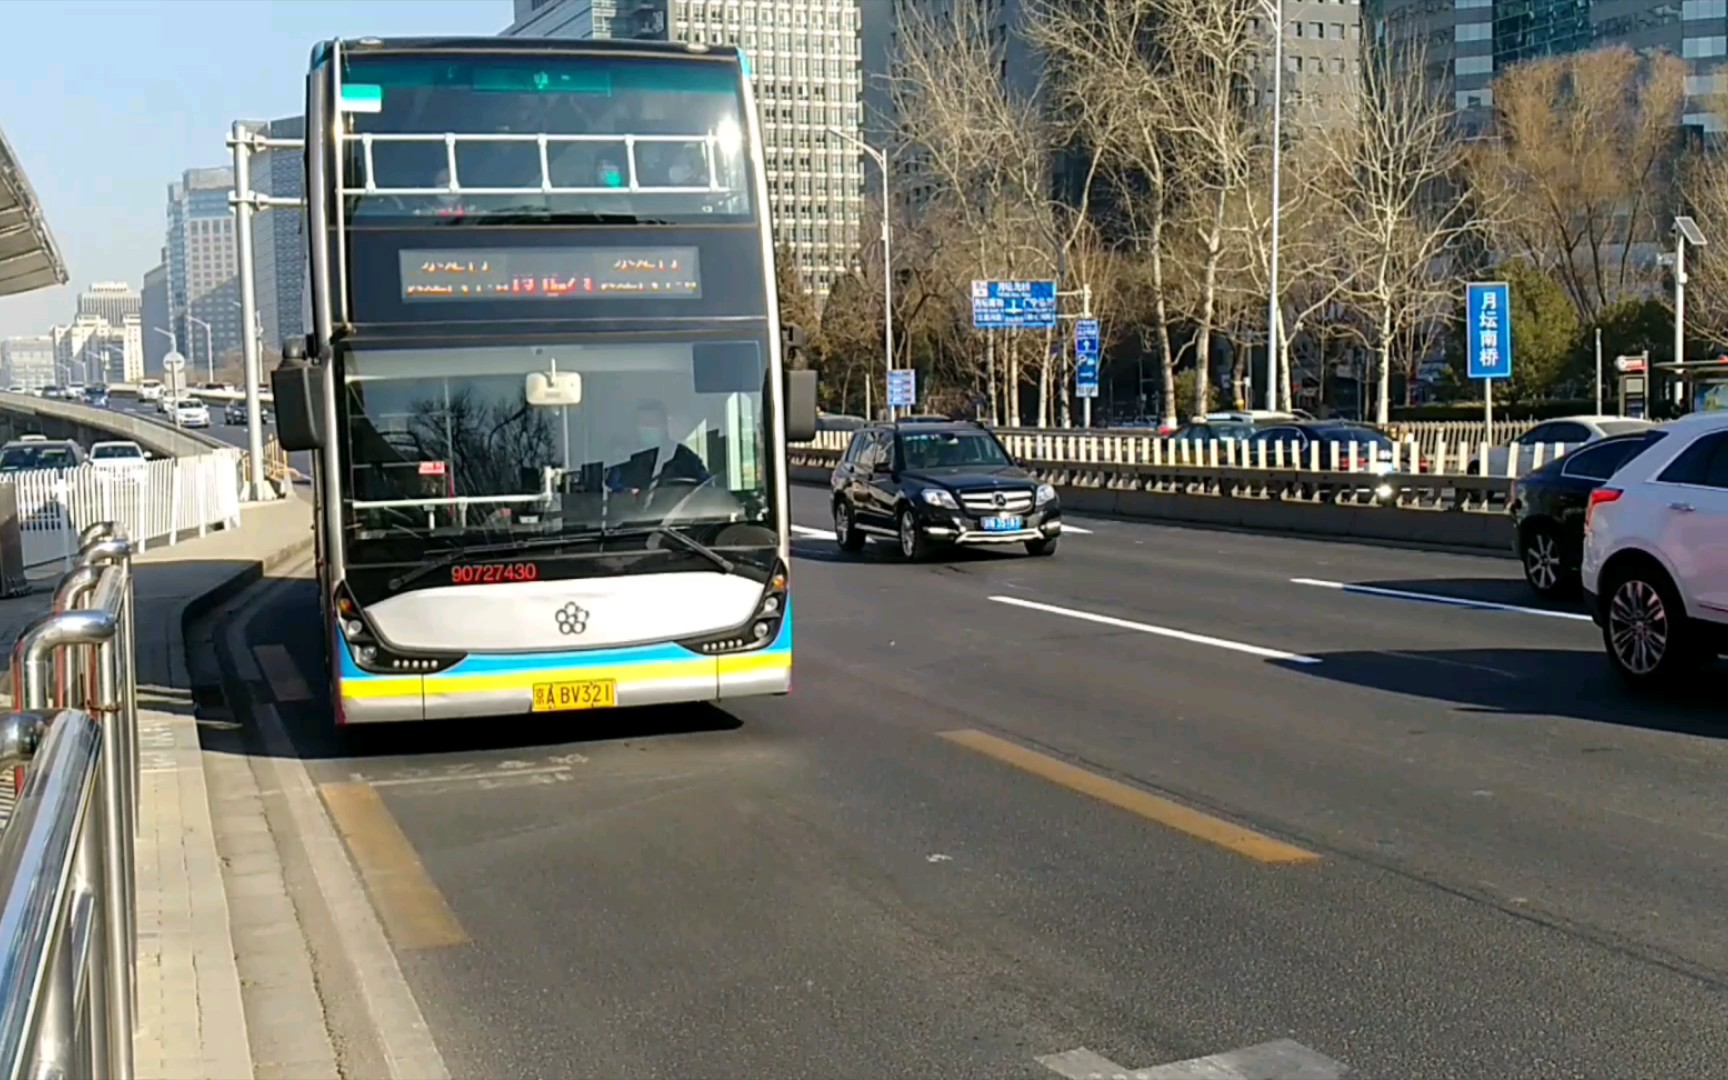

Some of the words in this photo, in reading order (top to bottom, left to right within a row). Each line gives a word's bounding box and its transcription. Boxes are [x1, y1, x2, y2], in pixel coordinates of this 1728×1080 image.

[1479, 291, 1499, 367] 月坛南桥
[451, 563, 537, 582] 90727430
